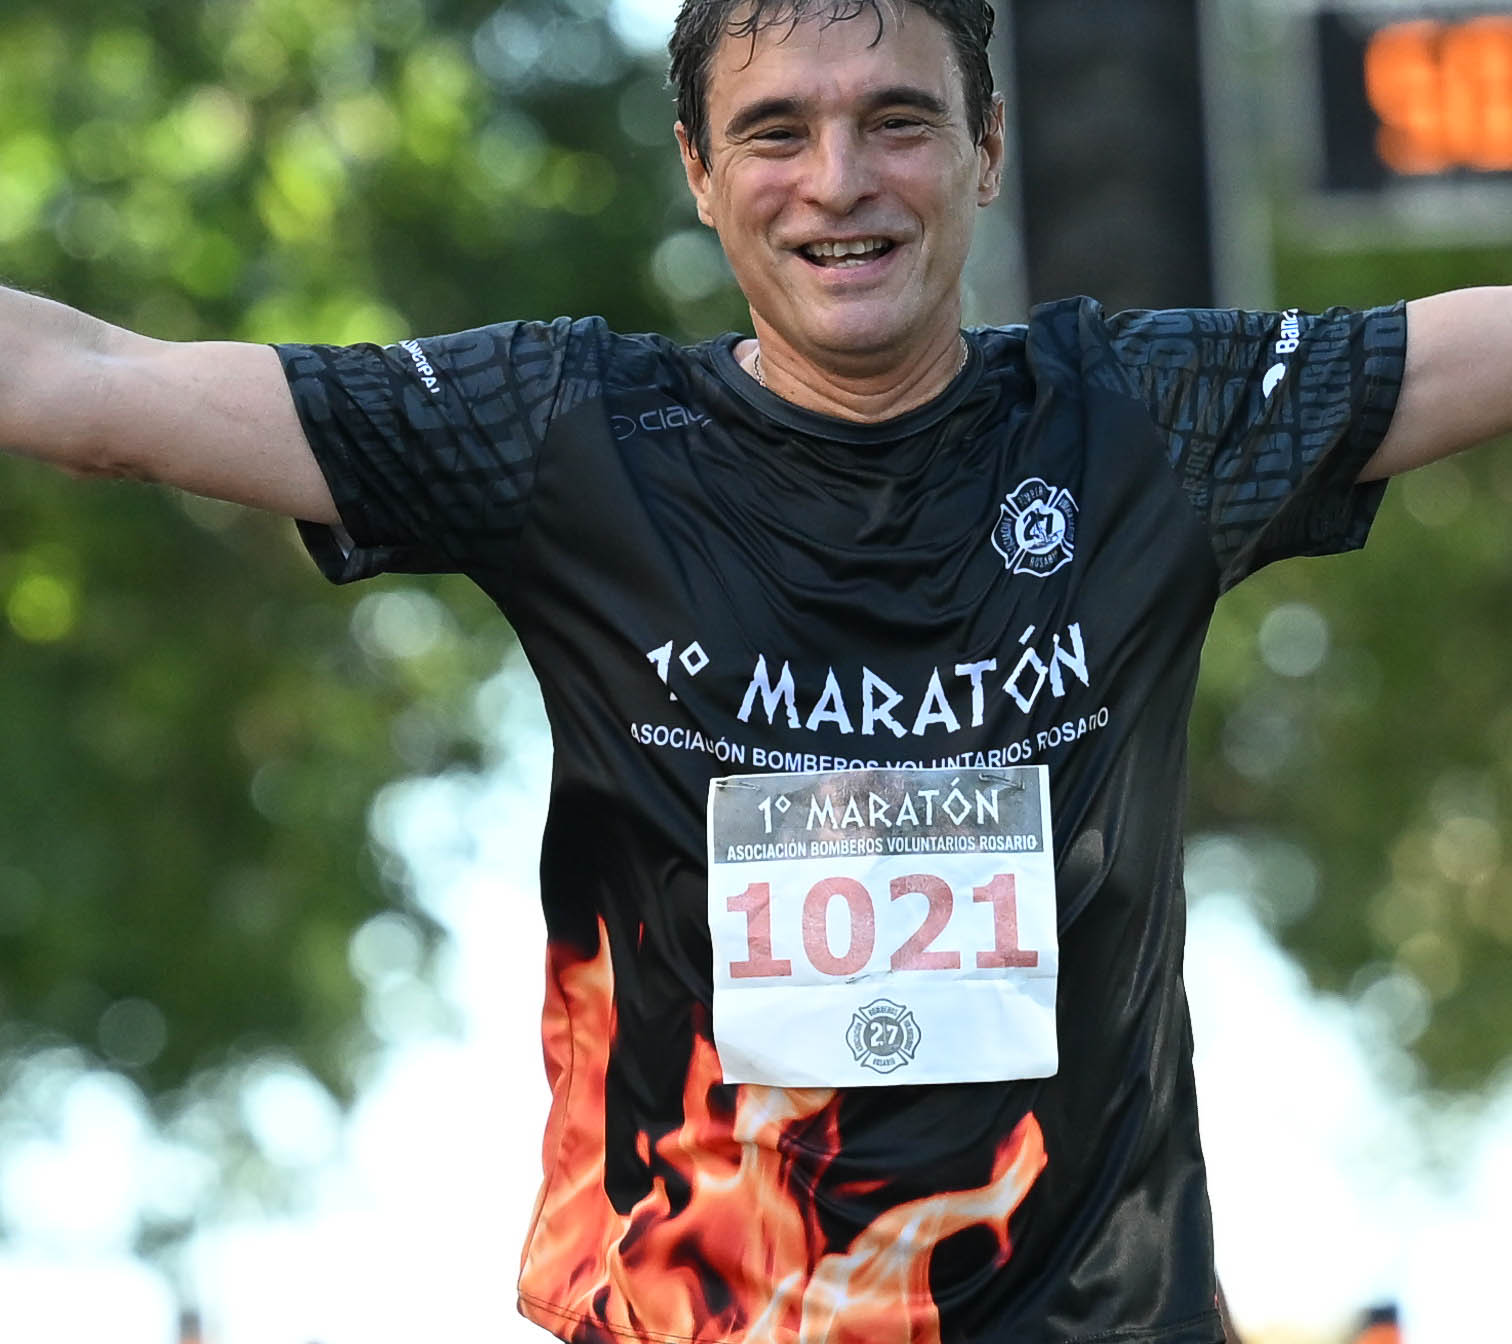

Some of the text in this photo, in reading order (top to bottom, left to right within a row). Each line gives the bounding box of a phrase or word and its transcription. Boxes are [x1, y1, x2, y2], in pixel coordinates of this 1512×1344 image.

[736, 621, 1090, 738] MARATÓN
[806, 777, 1000, 831] MARATÓN
[726, 833, 1038, 862] ASOCIACIÓN BOMBEROS VOLUNTARIOS ROSARIO
[726, 873, 1039, 978] 1021
[870, 1021, 899, 1047] 27
